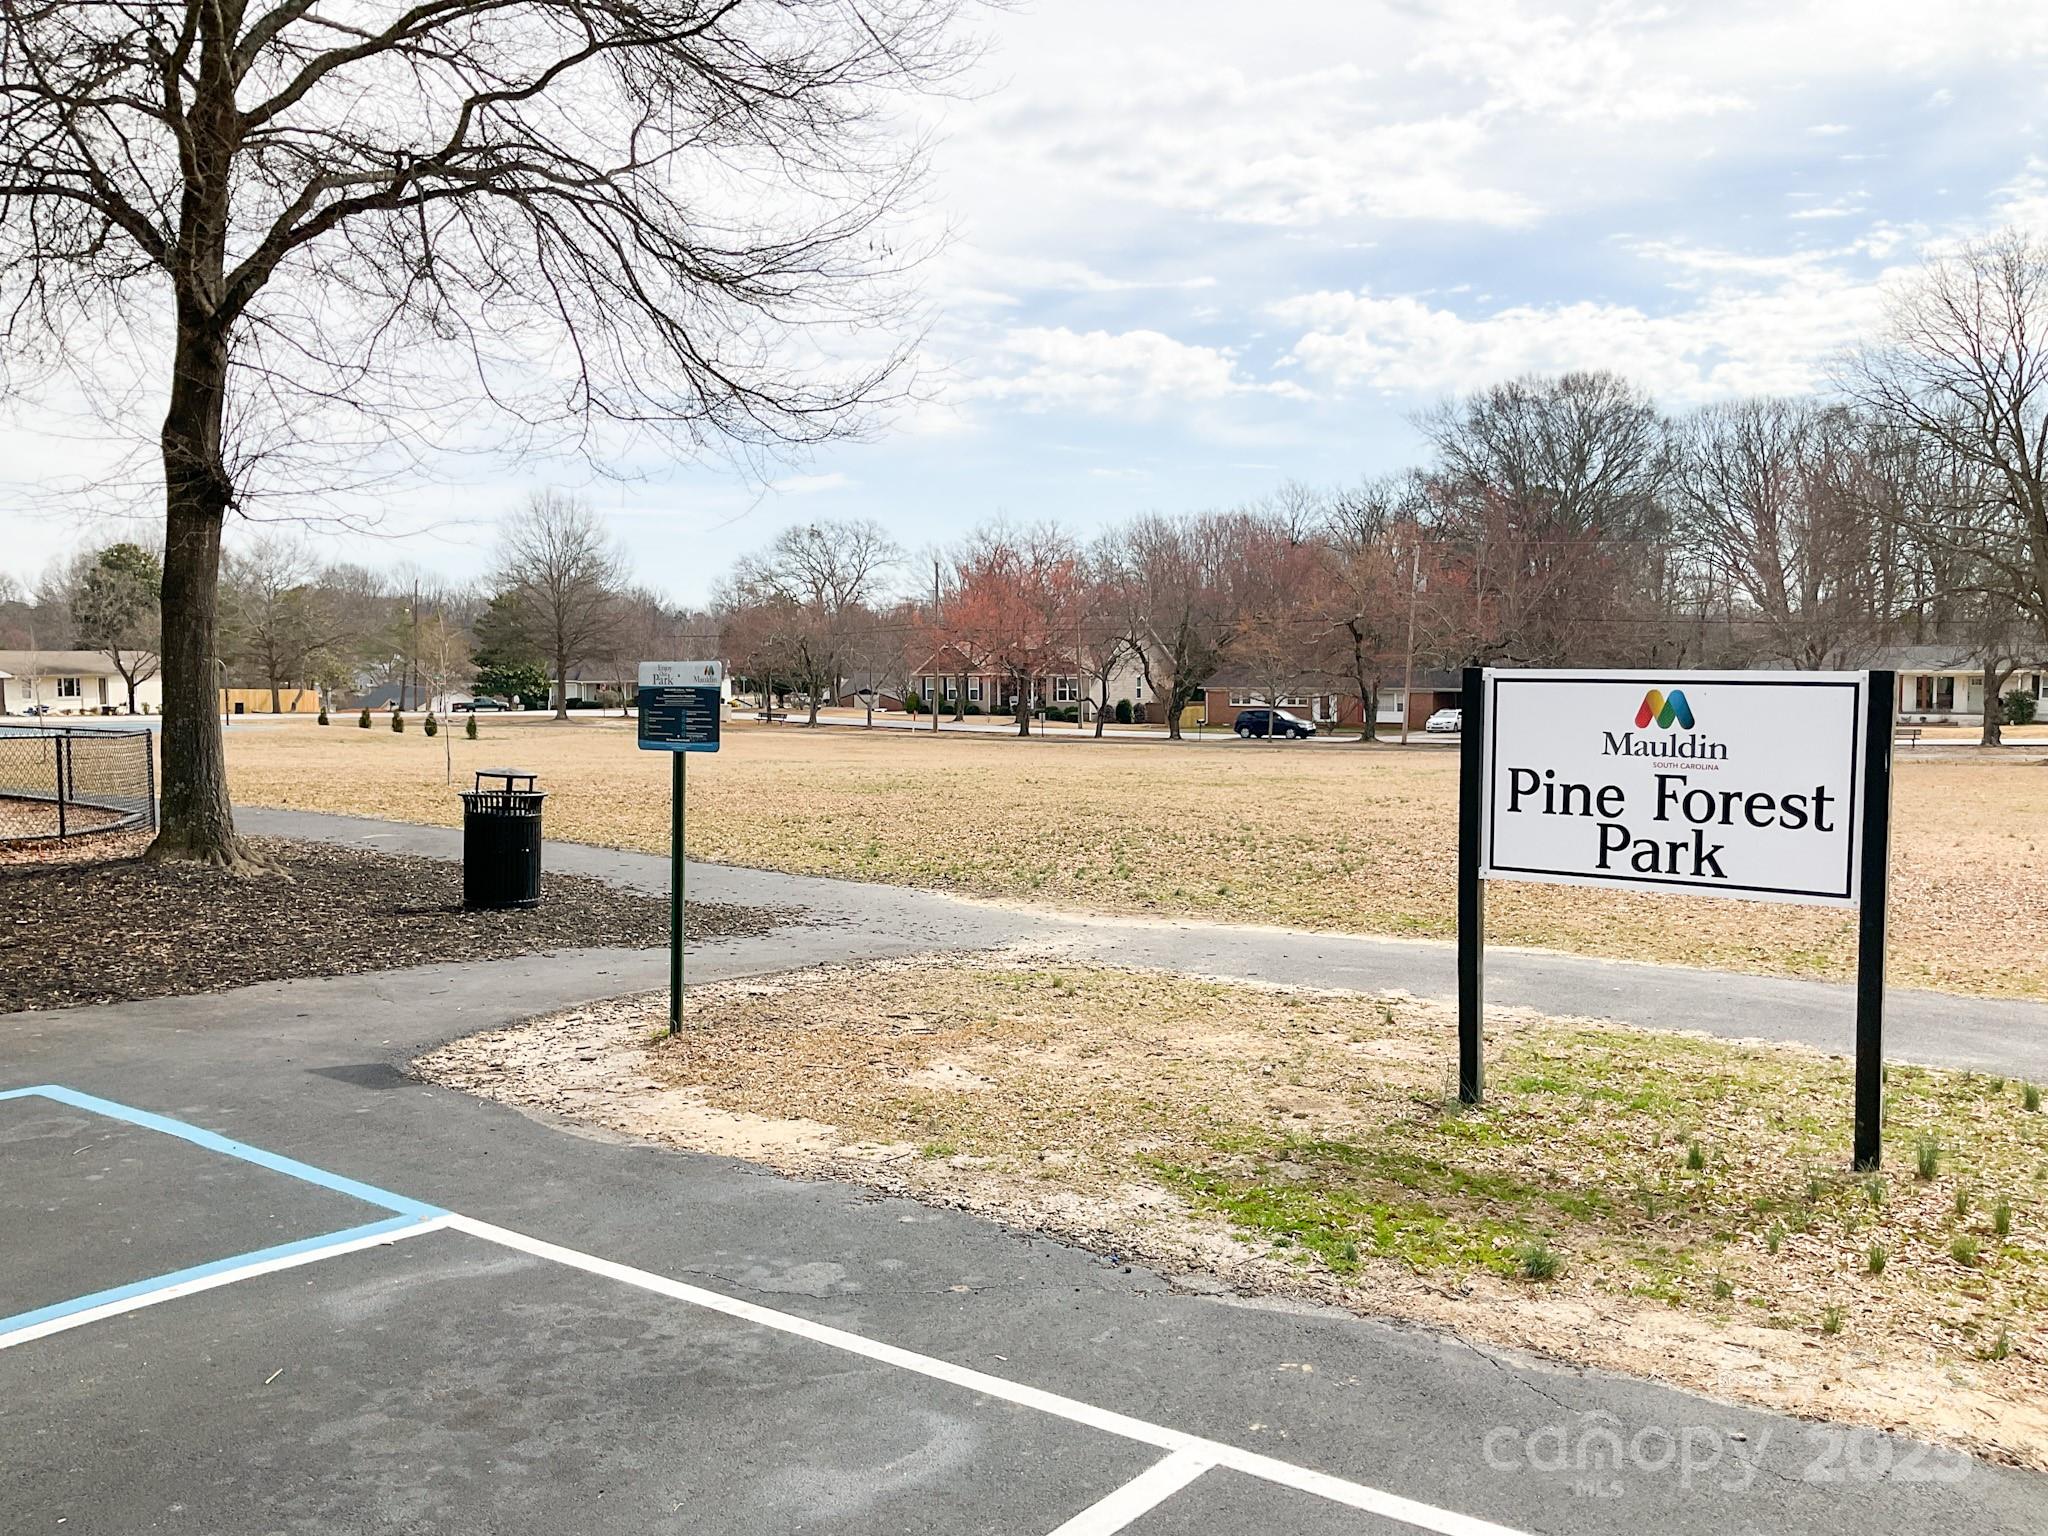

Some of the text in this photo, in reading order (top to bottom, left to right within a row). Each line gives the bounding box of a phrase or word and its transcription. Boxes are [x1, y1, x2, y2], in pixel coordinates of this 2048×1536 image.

[653, 674, 673, 685] Park
[1601, 731, 1729, 760] Mauldin
[1680, 763, 1719, 771] CAROLINA
[1507, 768, 1834, 832] Pine Forest
[1595, 822, 1728, 879] Park
